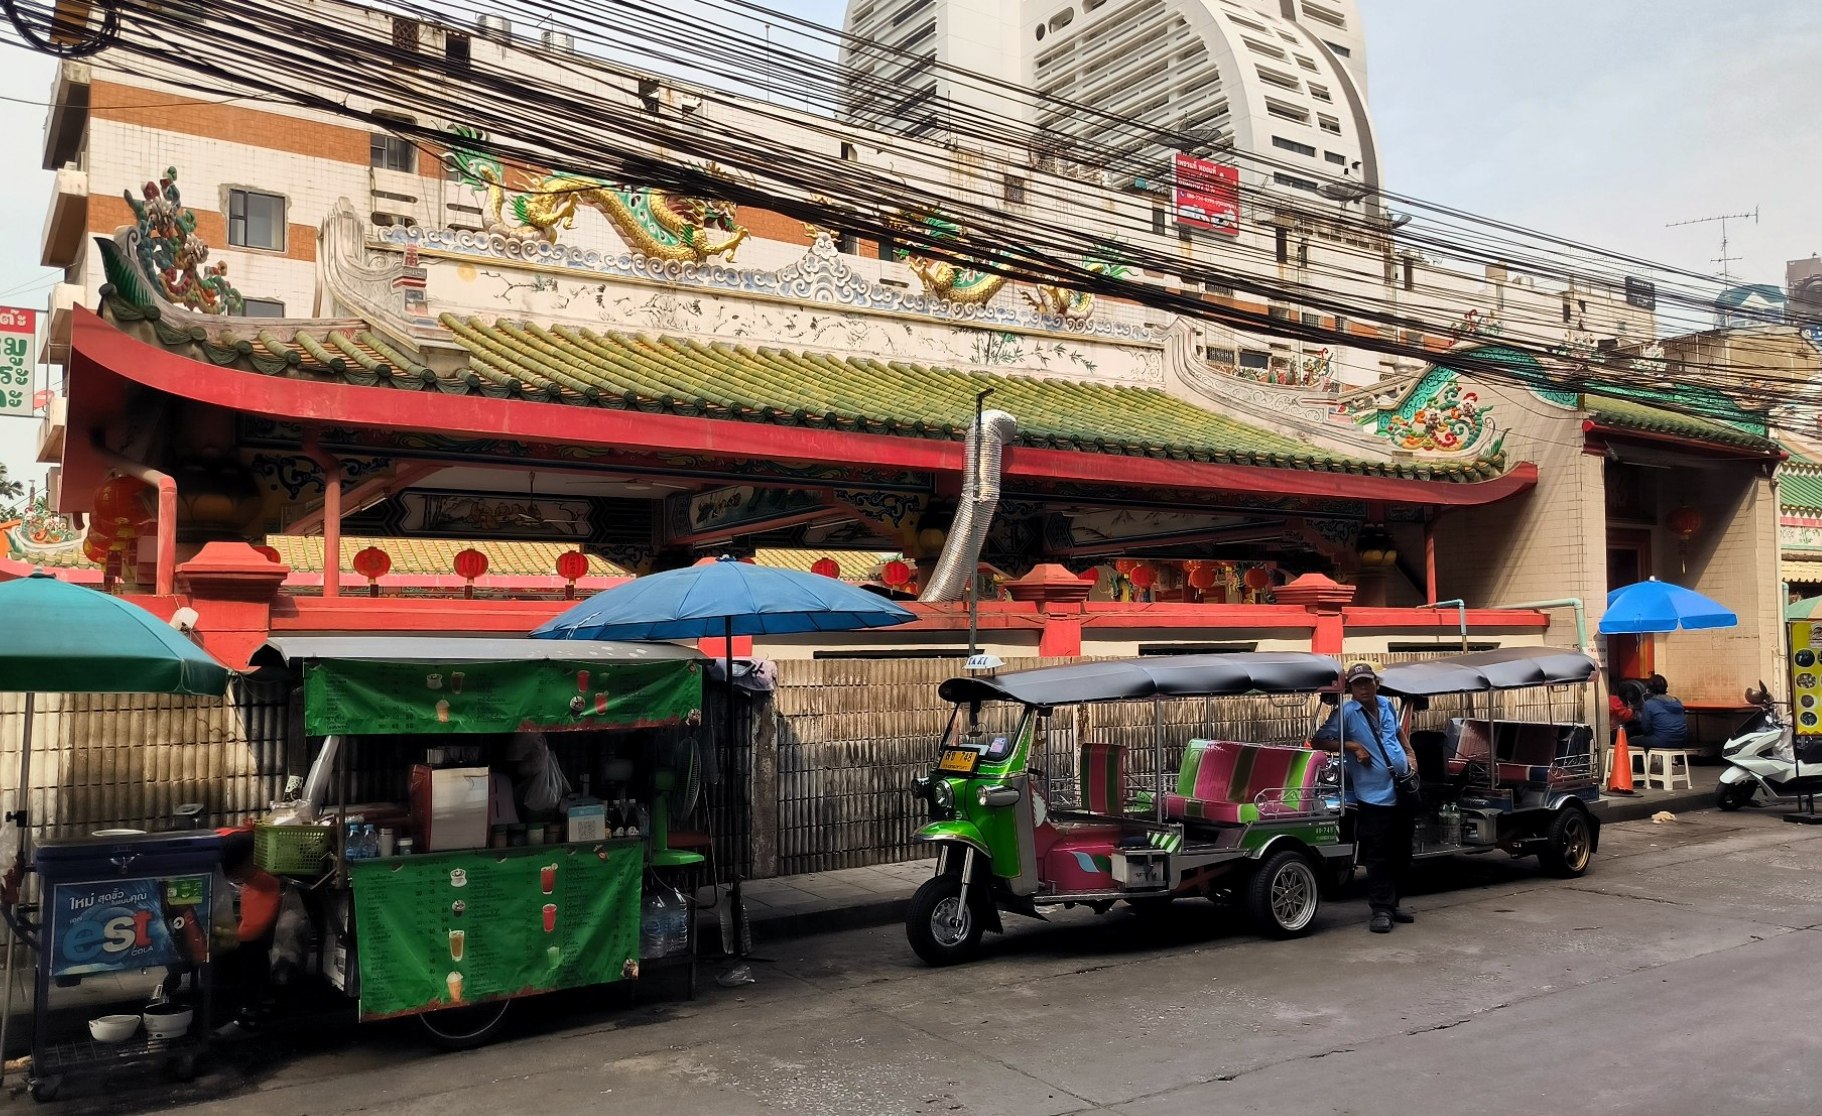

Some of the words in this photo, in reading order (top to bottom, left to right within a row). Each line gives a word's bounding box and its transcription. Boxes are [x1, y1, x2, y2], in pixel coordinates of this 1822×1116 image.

[0, 337, 28, 367] มู
[70, 893, 94, 910] ใหม่
[62, 908, 154, 963] est
[130, 946, 153, 956] COLA
